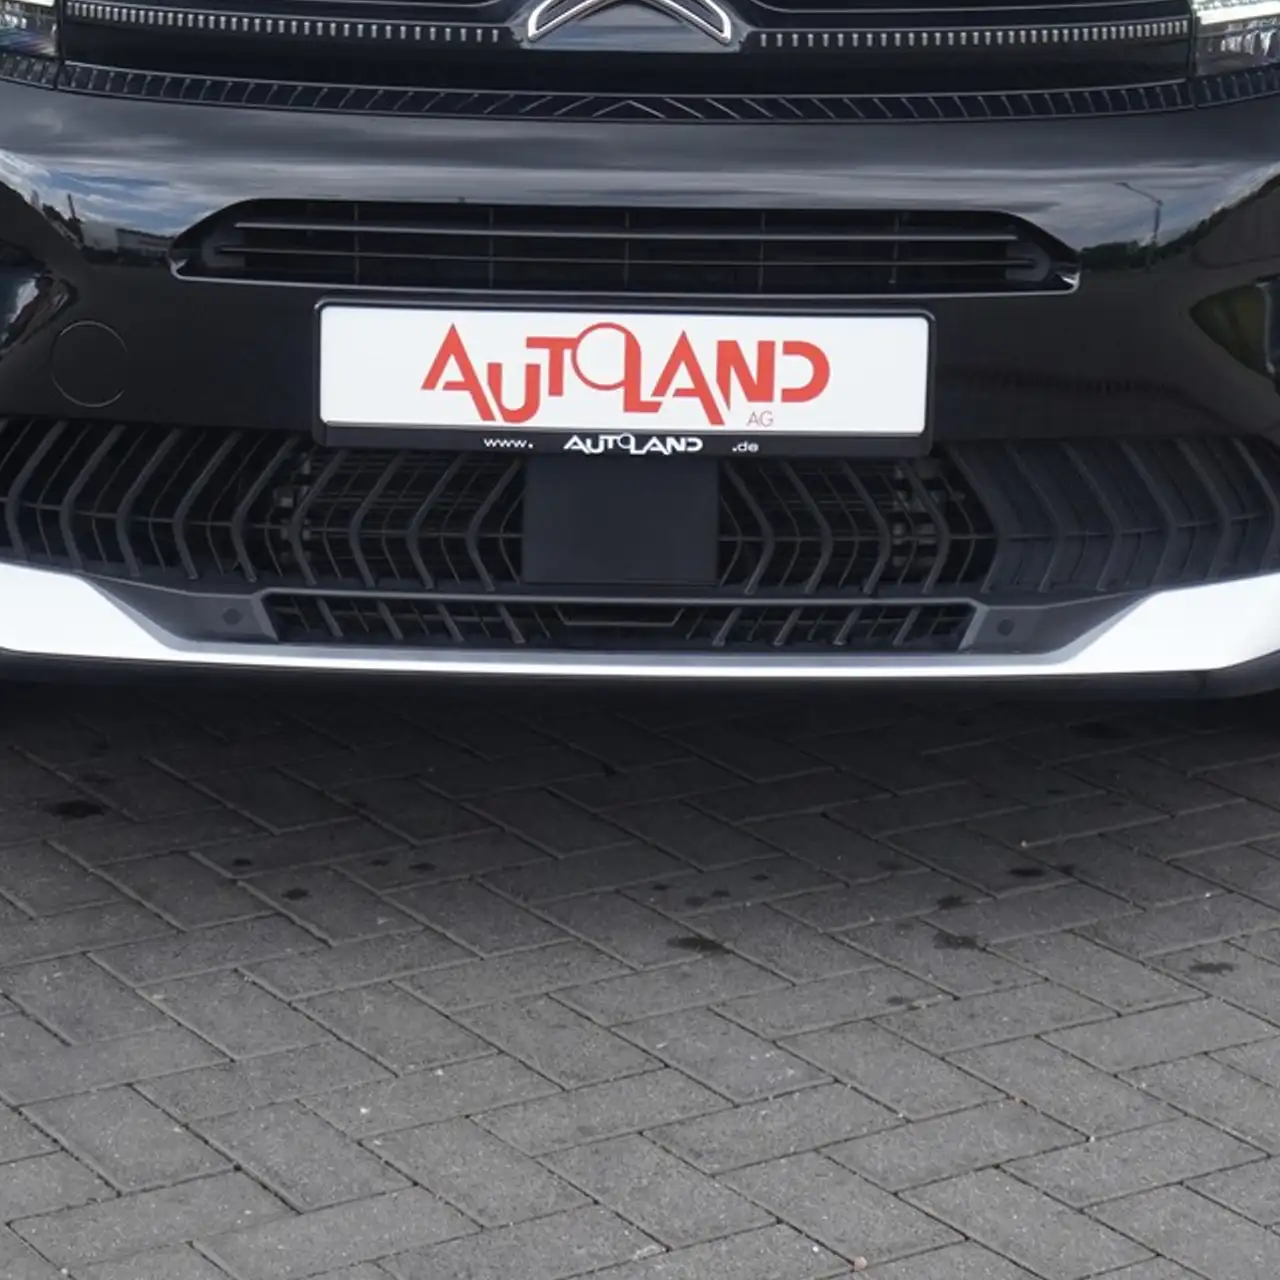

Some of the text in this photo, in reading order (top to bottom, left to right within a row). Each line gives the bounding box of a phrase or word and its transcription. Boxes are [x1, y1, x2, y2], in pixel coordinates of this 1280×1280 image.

[746, 411, 774, 428] AG
[483, 437, 534, 449] www.
[731, 441, 760, 453] .de
